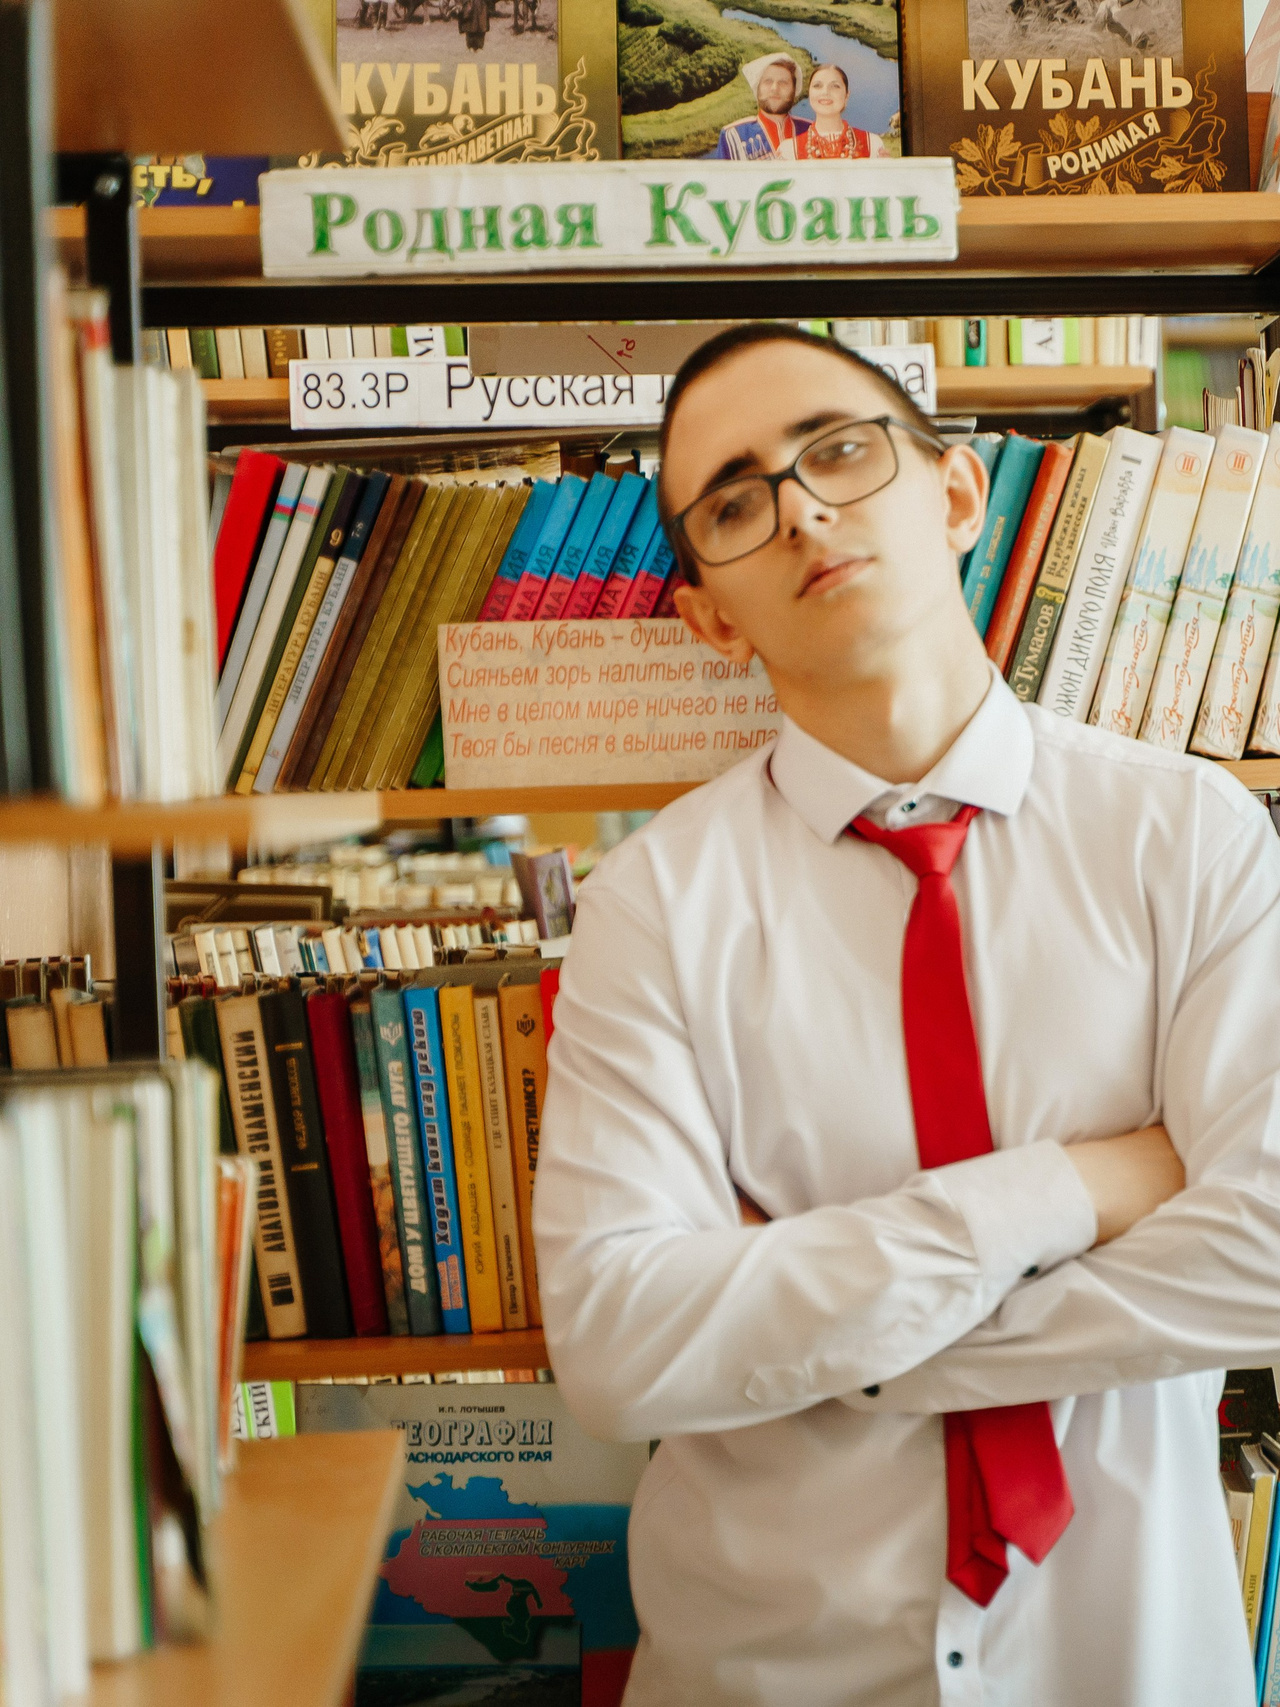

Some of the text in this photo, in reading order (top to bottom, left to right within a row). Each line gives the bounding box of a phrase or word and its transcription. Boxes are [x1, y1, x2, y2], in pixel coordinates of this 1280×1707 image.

[341, 62, 557, 115] КУБАНЬ
[962, 57, 1193, 111] КУБАНЬ
[1047, 111, 1161, 180] РОДИМАЯ
[306, 178, 941, 262] Родная Кубань
[303, 371, 409, 410] 83.3Р
[446, 363, 634, 421] Русская
[1045, 565, 1057, 577] На
[1053, 513, 1073, 562] рубежах
[299, 570, 327, 634] КУБАНИ
[287, 562, 348, 705] ЛИТЕРАТУРА КУБАНИ
[445, 625, 523, 657] Кубань,
[532, 622, 604, 656] Кубань
[630, 620, 684, 653] души
[1015, 604, 1054, 682] Тумасов
[1053, 669, 1084, 717] ОМОН
[1086, 552, 1115, 599] ПОЛЯ
[447, 659, 755, 690] Сияньем зорь налитые поля.
[448, 692, 778, 725] Мне в целом мире ничего не на
[450, 733, 496, 758] Твоя
[503, 731, 531, 757] бы
[539, 733, 599, 756] песня
[605, 732, 616, 753] в
[623, 729, 706, 753] вышине
[233, 1029, 270, 1154] ЗНАМЕНСКИЙ
[388, 1060, 408, 1108] ЛУГА
[412, 1008, 451, 1245] Ходят кони над рекою
[406, 1246, 428, 1294] ДОМ
[405, 1450, 552, 1465] АСНОДАРСКОГО КРАЯ
[420, 1528, 546, 1542] РАБОЧАЯ ТЕТРАДЬ
[420, 1540, 616, 1556] С КОМПЛЕКТОМ КОНТУРНЫХ
[554, 1555, 590, 1568] КАРТ
